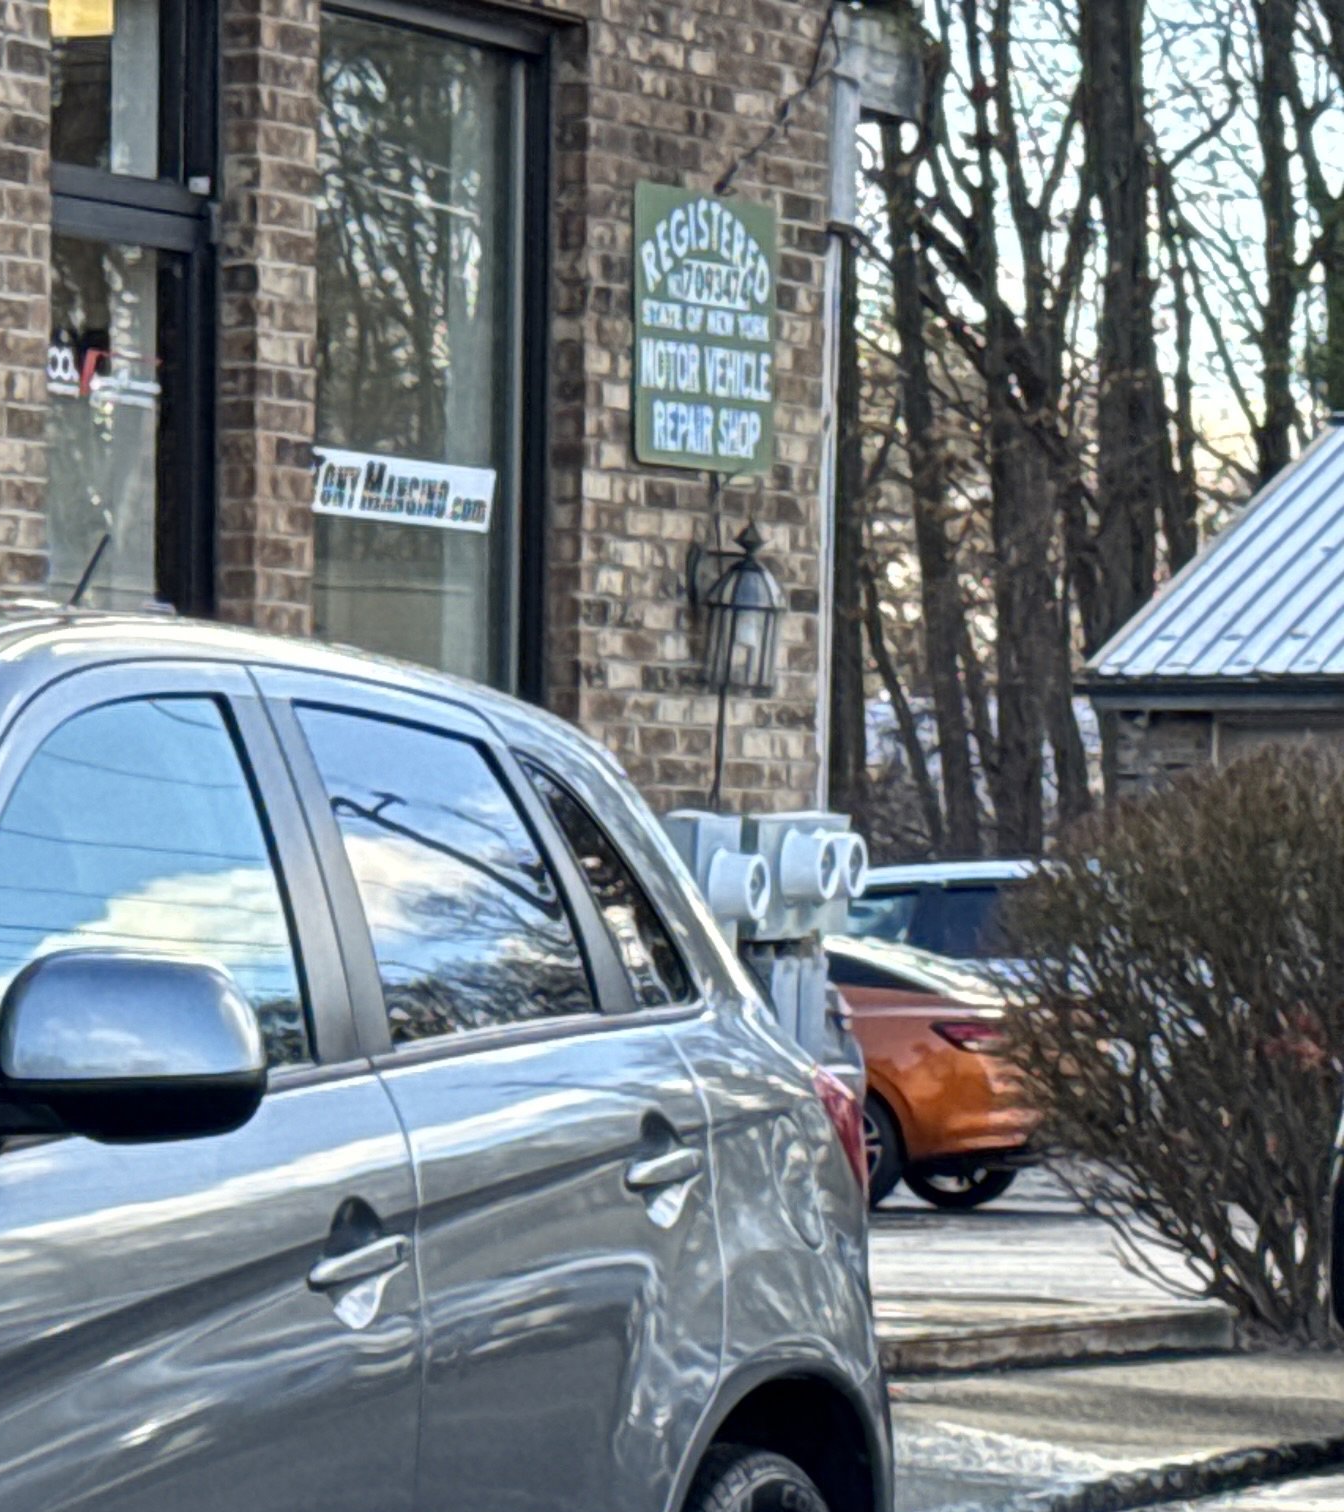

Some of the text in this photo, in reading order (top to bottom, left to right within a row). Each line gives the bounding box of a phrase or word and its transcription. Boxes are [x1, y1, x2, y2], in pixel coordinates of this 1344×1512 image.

[641, 198, 770, 304] REGISTERED
[642, 298, 683, 331] STATE
[686, 305, 703, 332] OF
[640, 338, 772, 402] MOTOR VEHICLE
[652, 399, 761, 459] REPAIR SHOP
